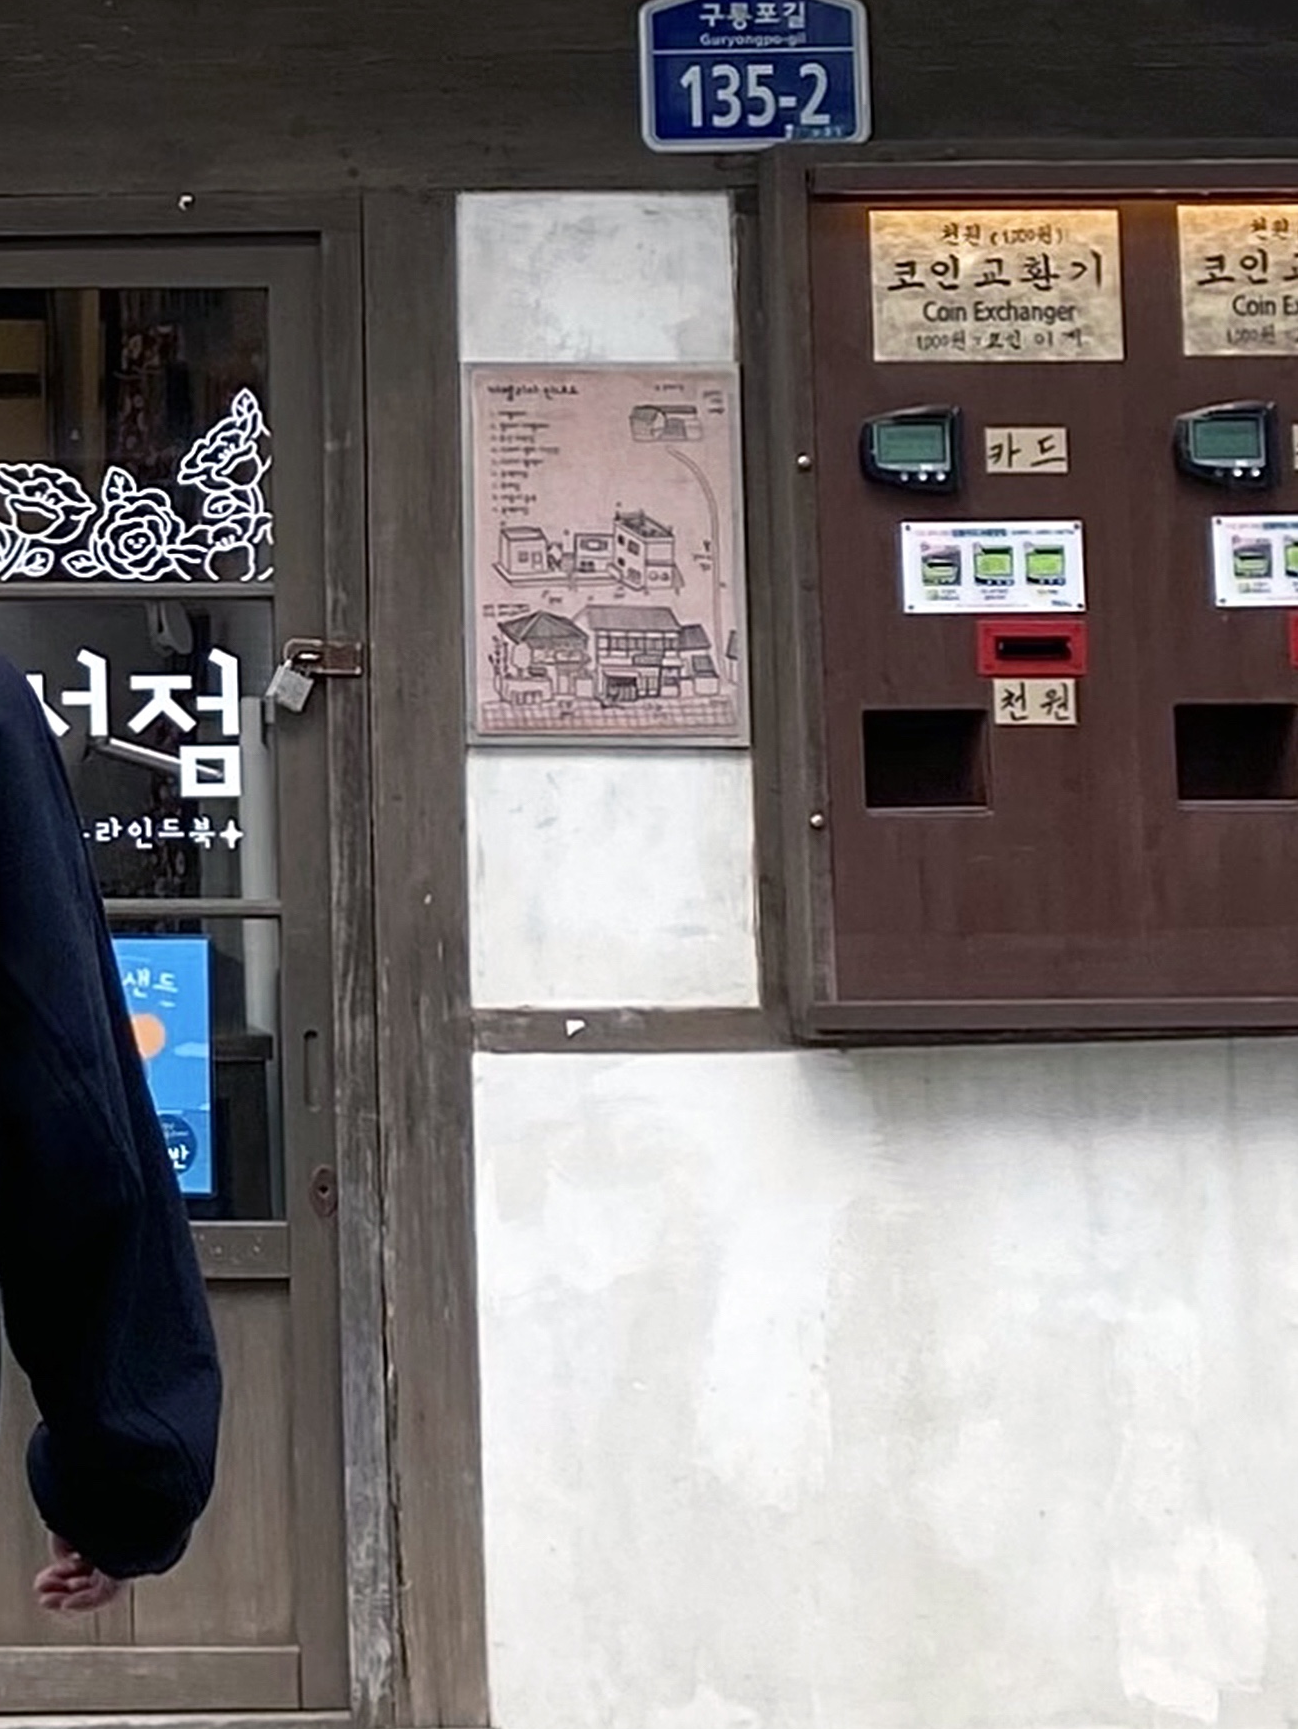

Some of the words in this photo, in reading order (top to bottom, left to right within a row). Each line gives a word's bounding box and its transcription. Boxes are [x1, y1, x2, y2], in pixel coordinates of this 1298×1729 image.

[699, 0, 806, 31] 구룡포길
[680, 61, 831, 128] 135-2
[887, 253, 960, 292] 코인
[973, 249, 1103, 292] 교환기
[1197, 247, 1269, 286] 코인
[923, 300, 968, 322] Coin
[973, 300, 1077, 327] Exchanger
[1232, 294, 1277, 317] Coin
[81, 816, 217, 849] 라인드북
